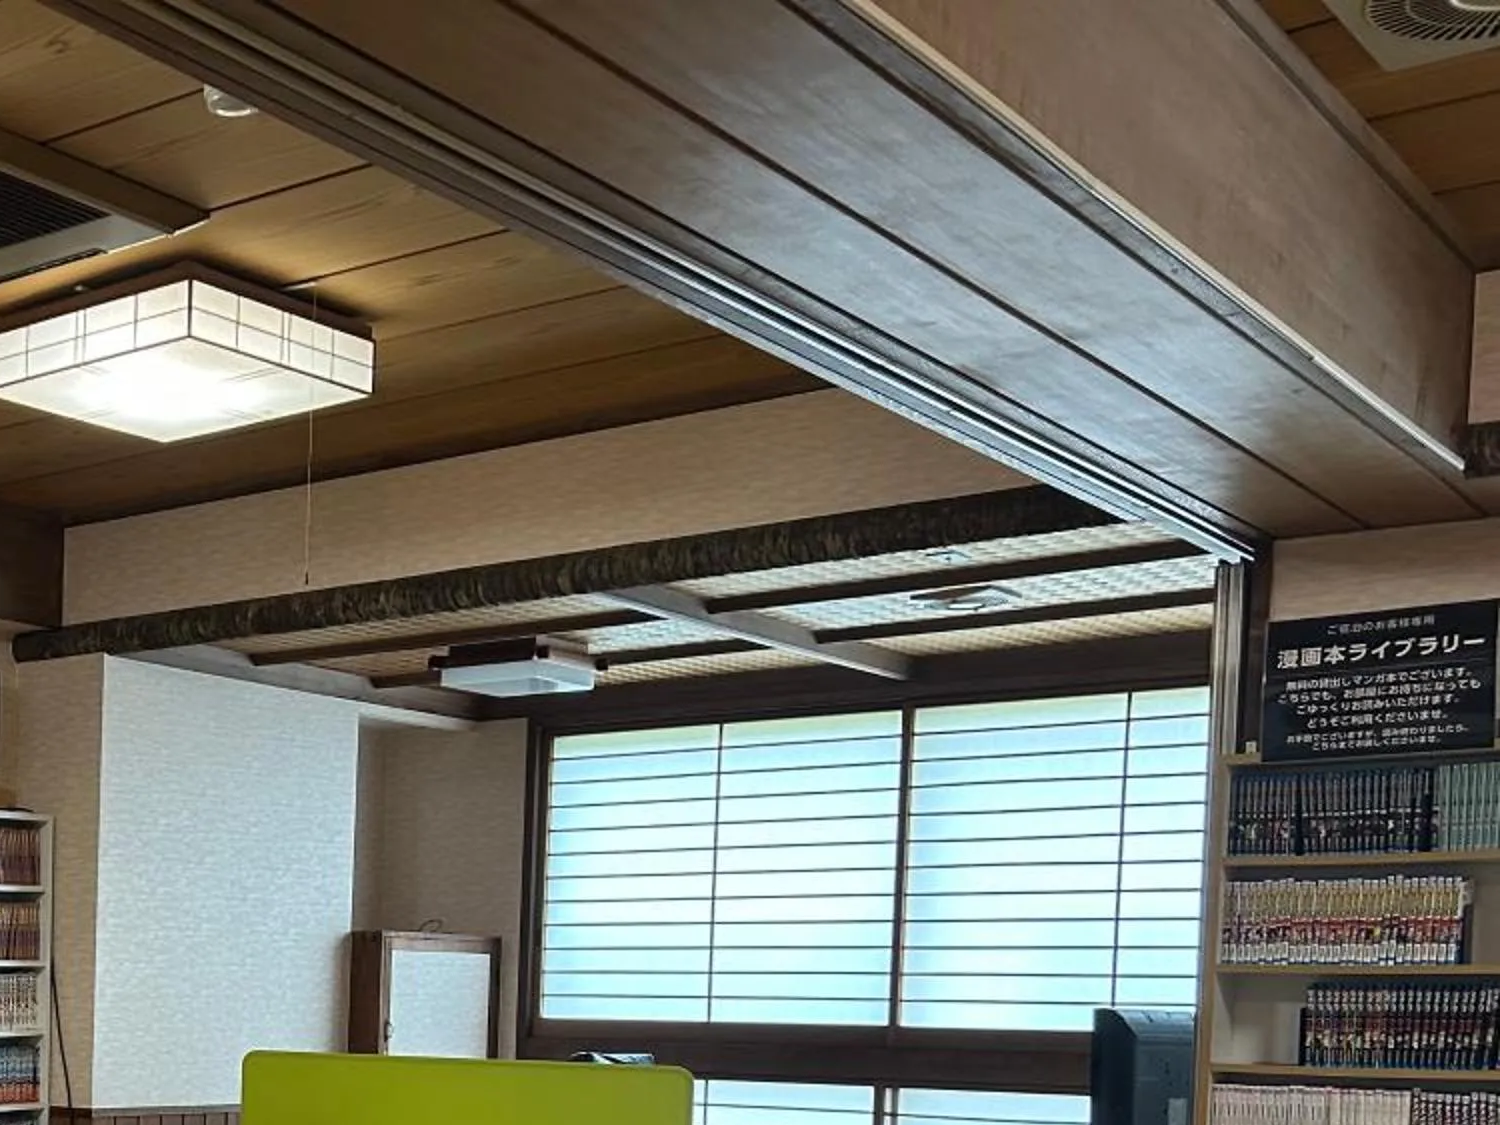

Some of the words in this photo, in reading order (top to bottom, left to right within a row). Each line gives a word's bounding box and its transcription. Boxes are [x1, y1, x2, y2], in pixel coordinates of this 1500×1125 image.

[1277, 634, 1486, 669] 漫画本ライブラリー
